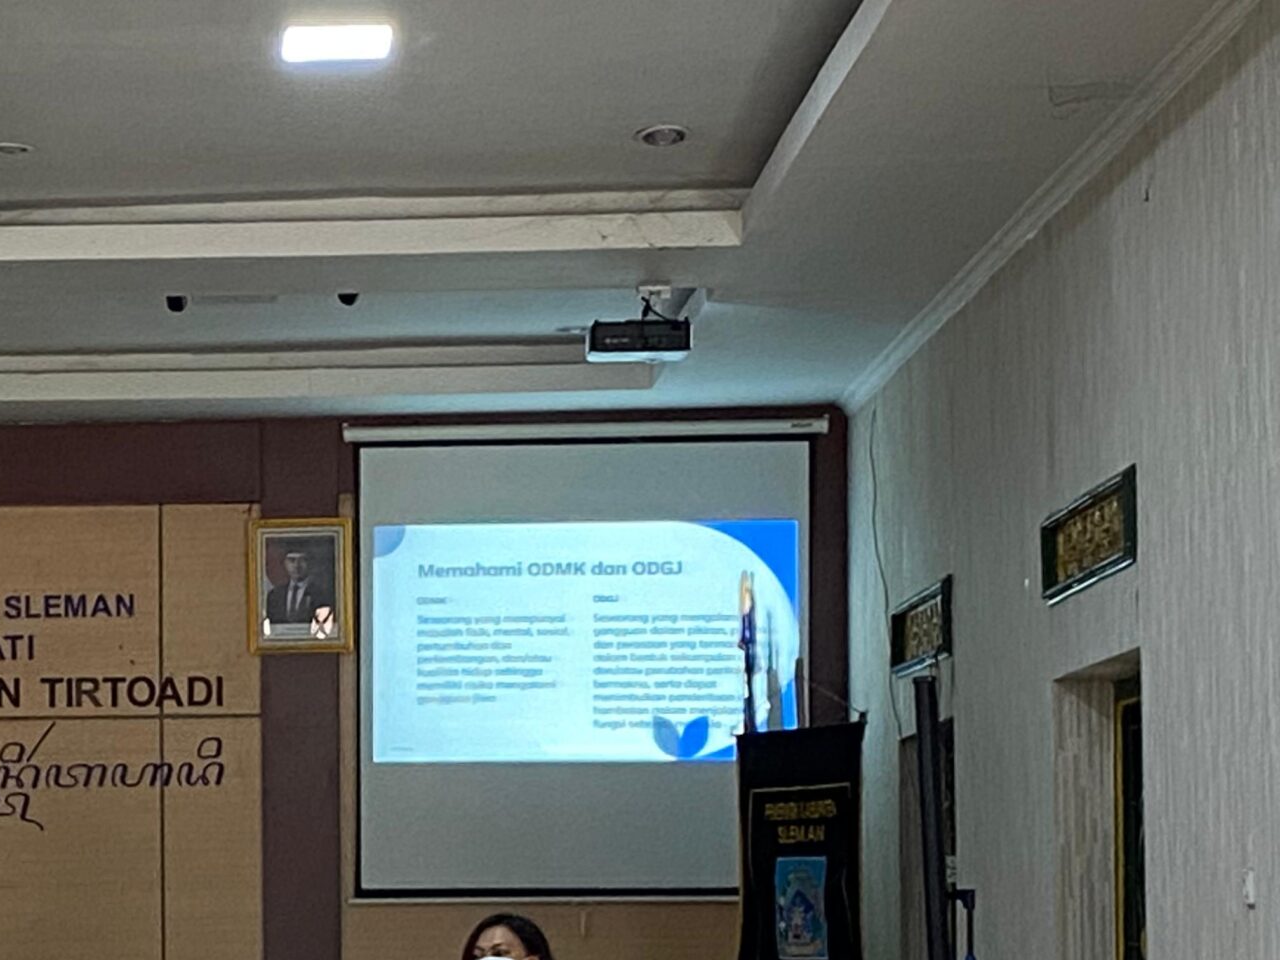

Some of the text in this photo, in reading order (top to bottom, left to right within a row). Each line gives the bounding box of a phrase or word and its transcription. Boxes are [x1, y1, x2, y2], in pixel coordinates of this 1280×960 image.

[417, 560, 683, 578] Memahami ODMK dan ODGJ
[3, 593, 135, 619] SLEMAN
[40, 675, 225, 709] TIRTOADI
